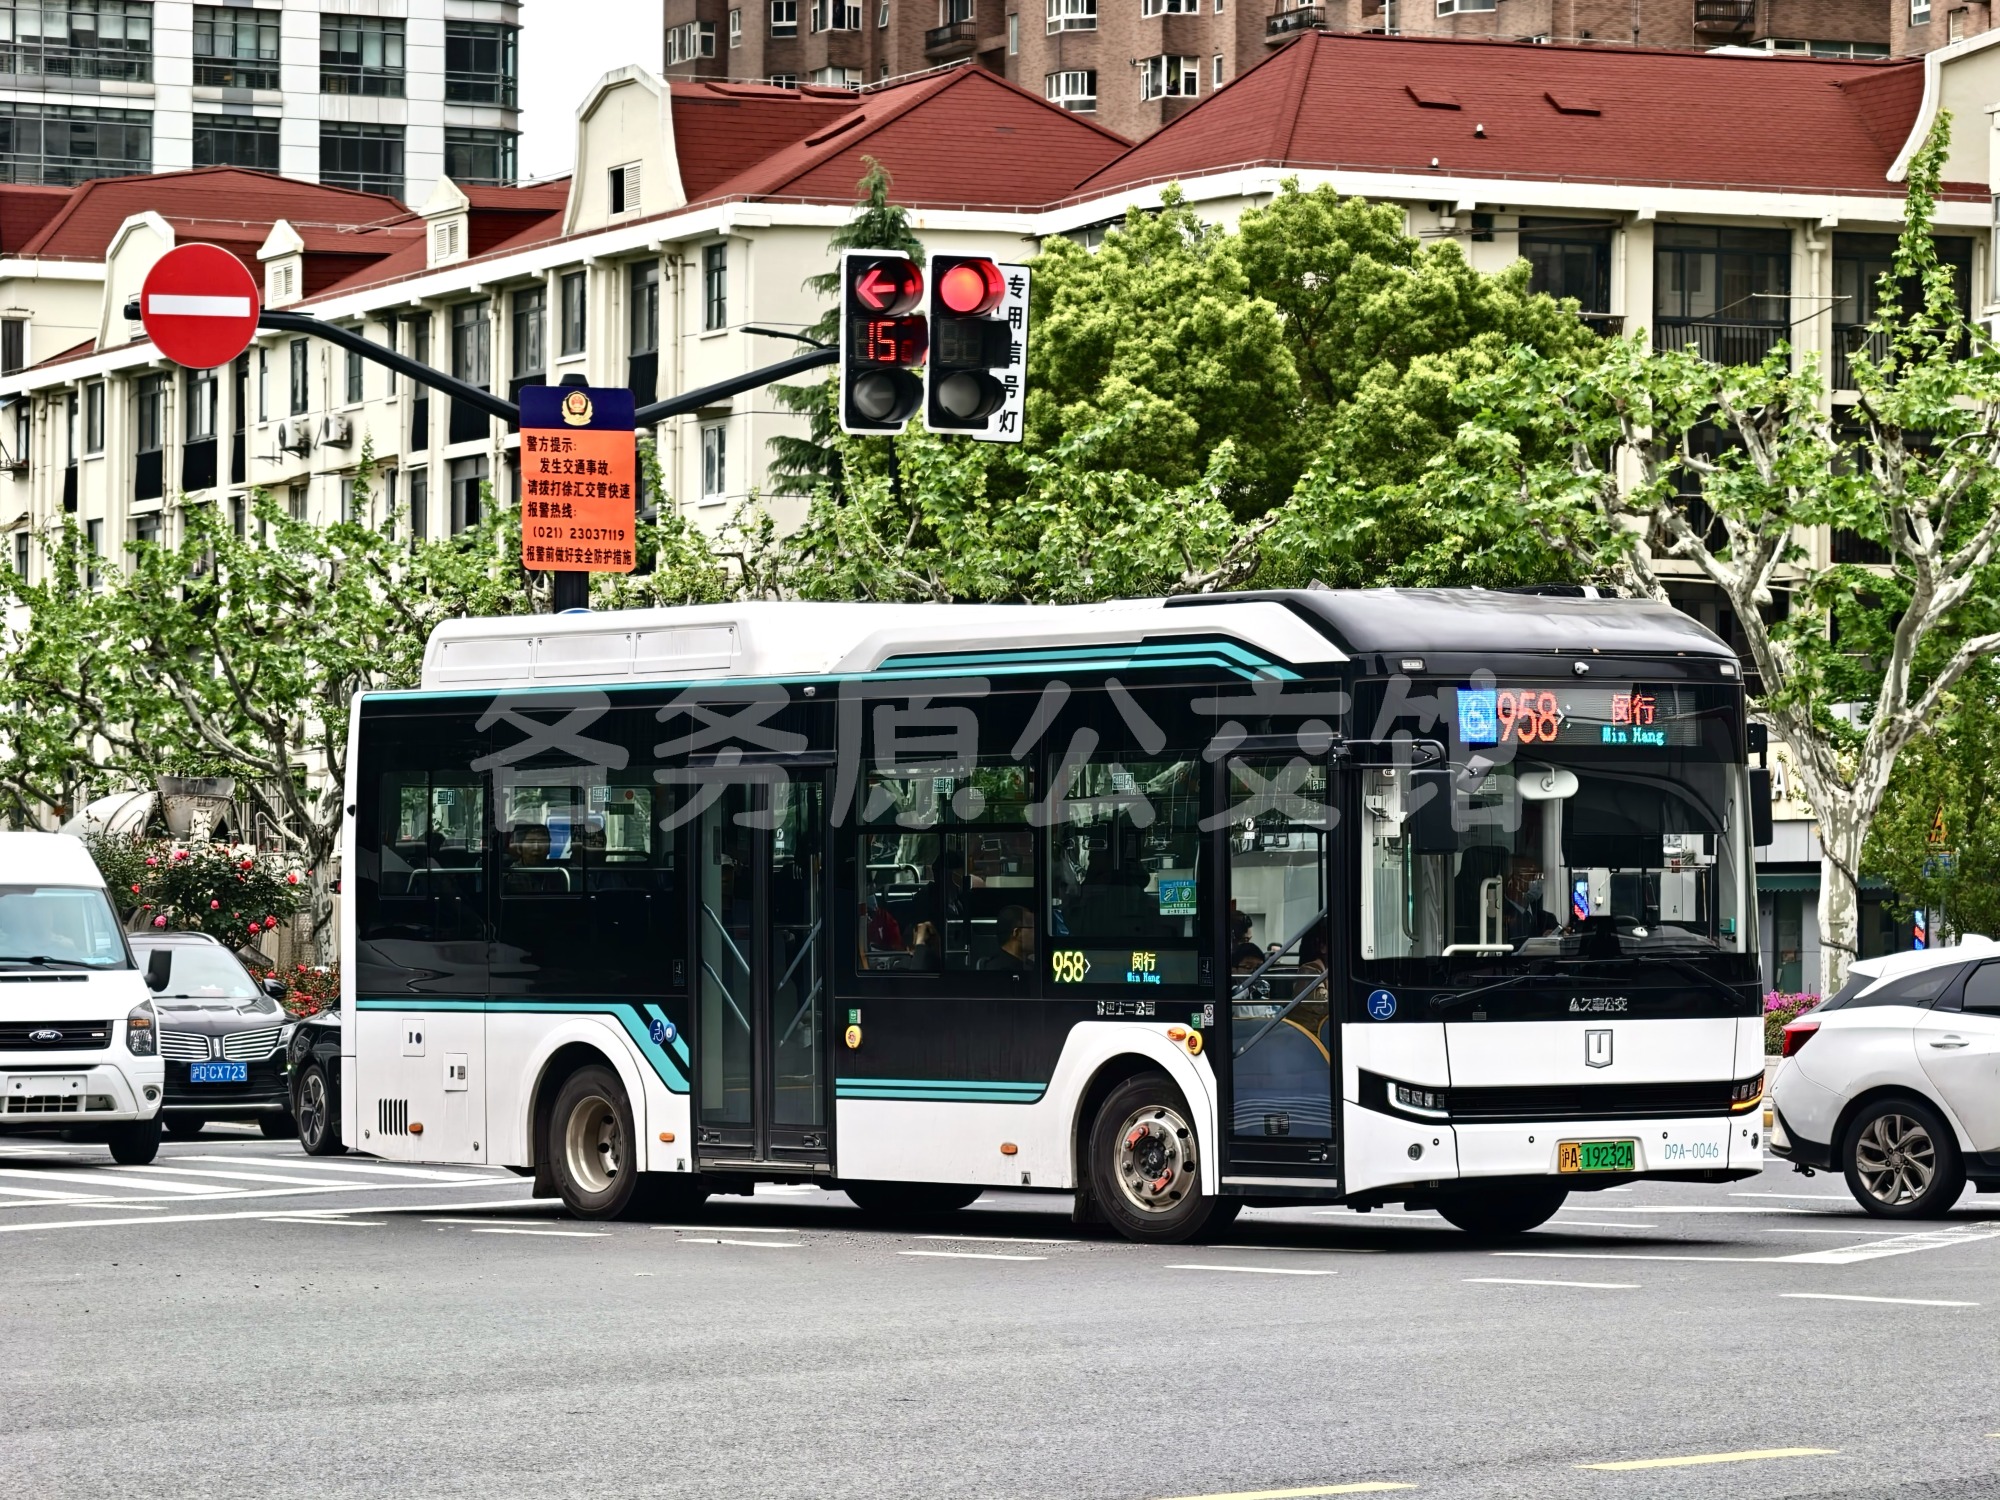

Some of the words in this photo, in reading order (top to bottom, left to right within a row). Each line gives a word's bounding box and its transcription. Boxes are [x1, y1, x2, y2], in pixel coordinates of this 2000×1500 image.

[868, 321, 896, 362] 15
[999, 274, 1026, 434] 专用信号灯
[527, 479, 631, 499] 请拨打徐汇交管快速
[532, 526, 563, 539] (021)
[570, 527, 625, 541] 23037119
[526, 545, 632, 566] 报警前做好安全防护措施
[1497, 691, 1559, 743] 958
[1612, 693, 1656, 725] 闵行
[1602, 726, 1627, 743] Min
[1632, 726, 1665, 746] Hang
[1052, 951, 1084, 983] 958
[1131, 952, 1156, 972] 闵行
[1664, 1142, 1719, 1160] D9A-0046
